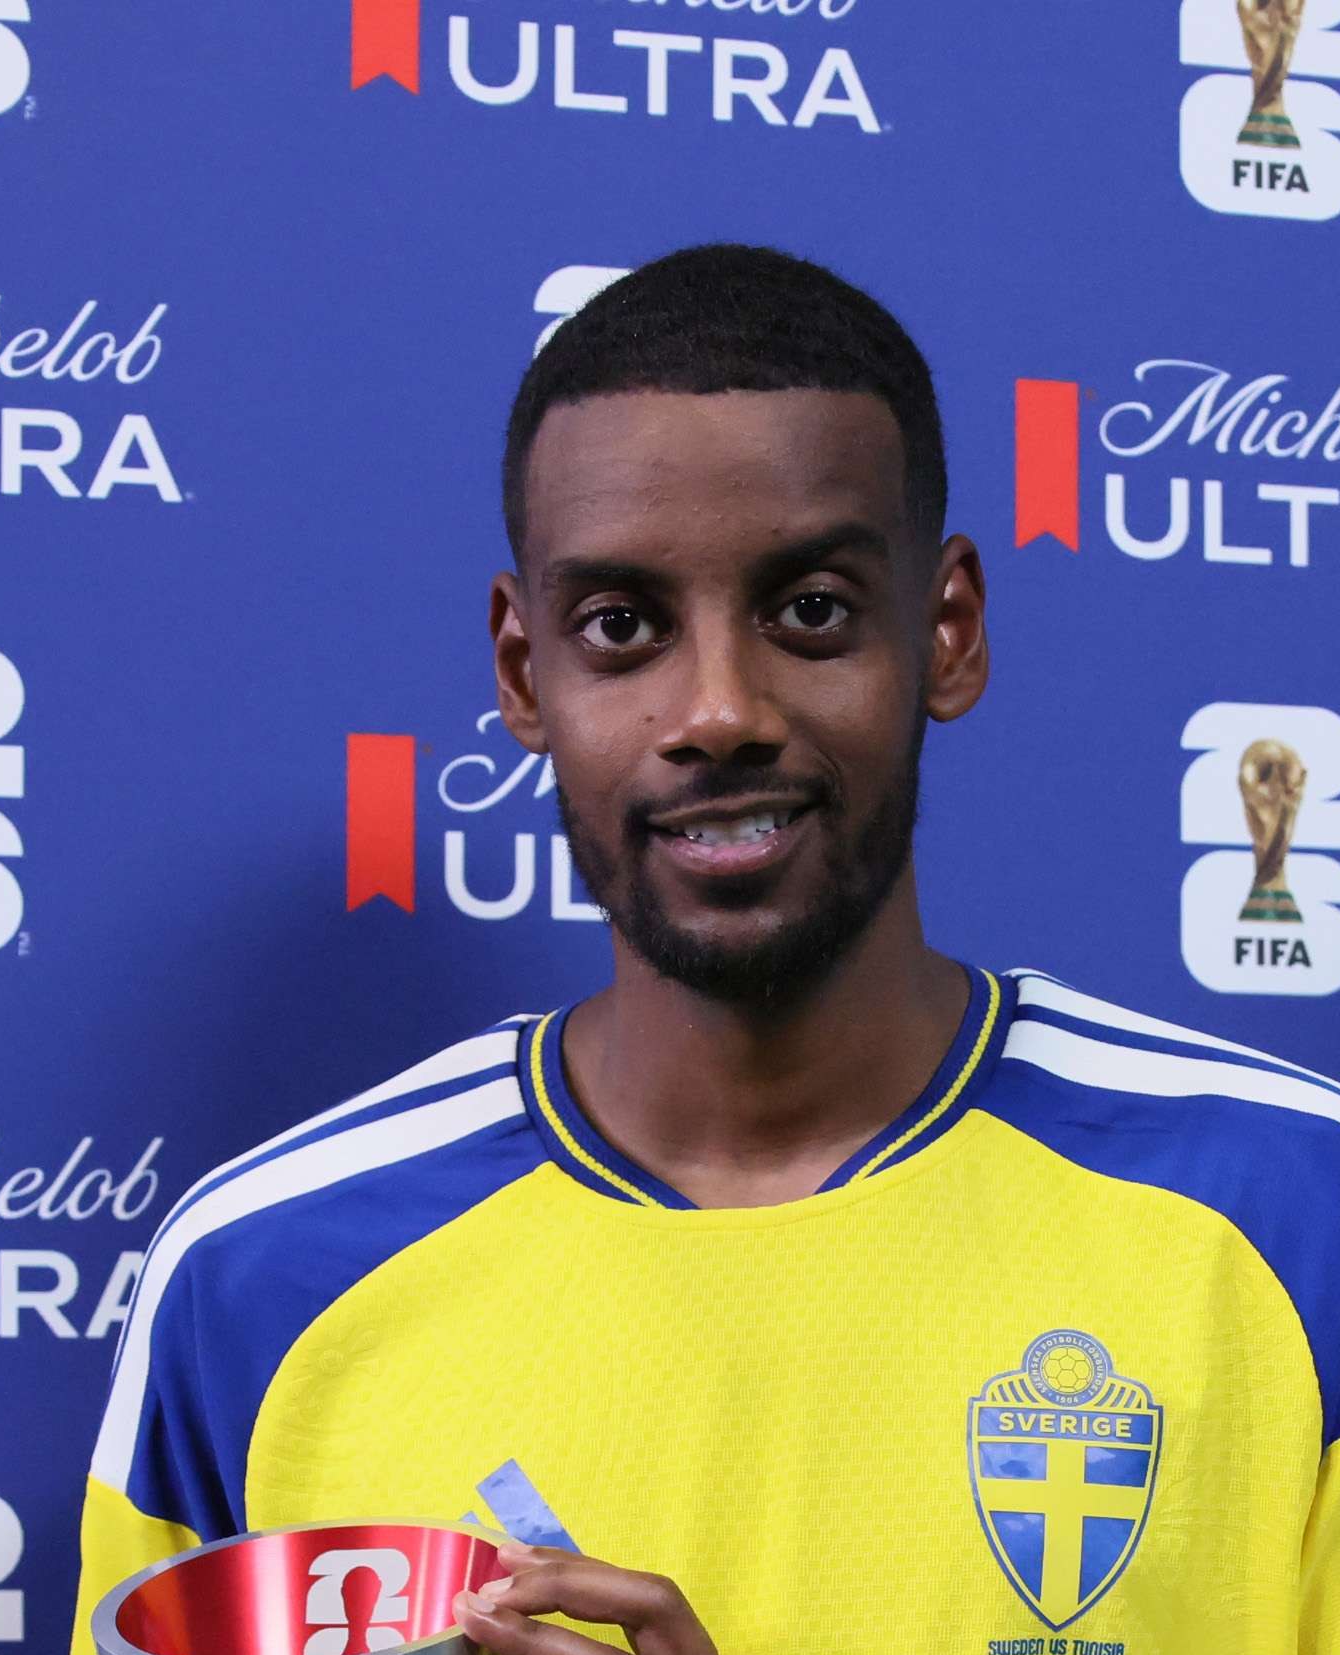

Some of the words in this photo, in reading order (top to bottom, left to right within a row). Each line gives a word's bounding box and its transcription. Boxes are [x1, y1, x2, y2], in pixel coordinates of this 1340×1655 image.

[449, 16, 881, 134] ULTRA
[1233, 159, 1309, 193] FIFA
[1235, 937, 1311, 968] FIFA
[999, 1411, 1133, 1438] SVERIGE
